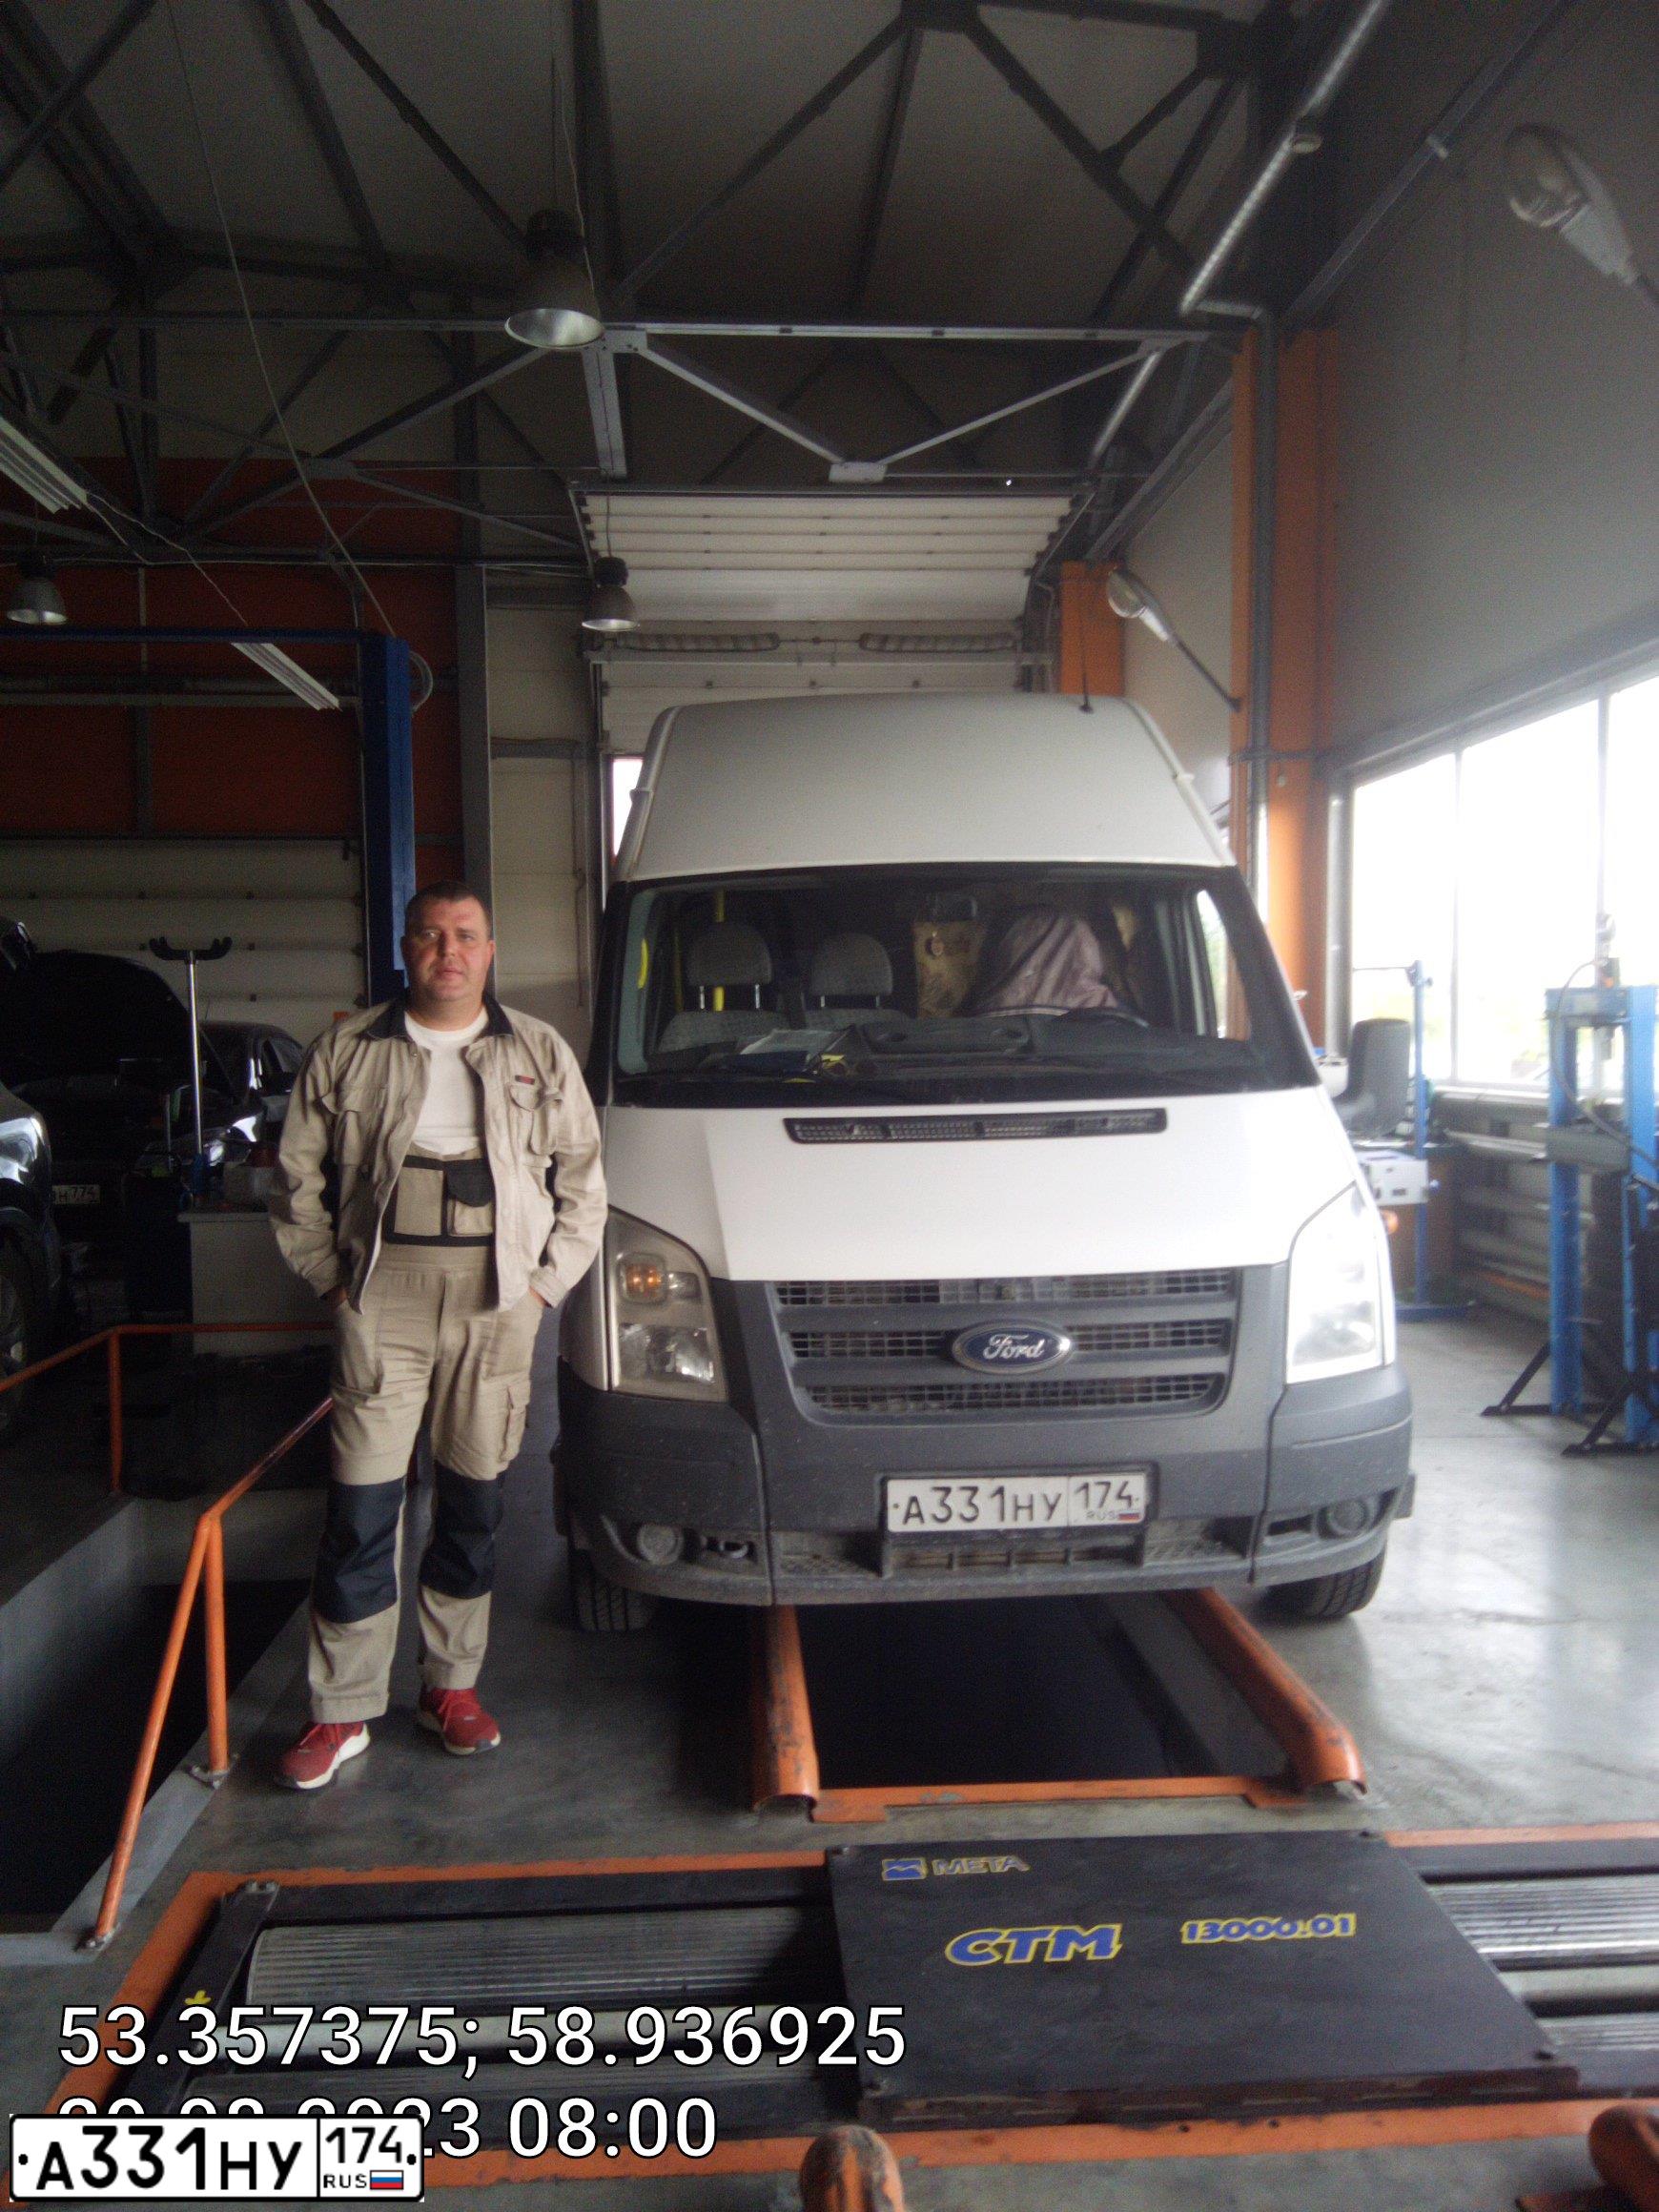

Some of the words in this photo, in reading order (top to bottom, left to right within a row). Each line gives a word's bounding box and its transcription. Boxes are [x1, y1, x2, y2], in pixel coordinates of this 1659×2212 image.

[982, 1334, 1046, 1360] Ford
[902, 1485, 1062, 1526] А331НУ
[1075, 1480, 1135, 1509] 174
[1180, 1913, 1357, 1944] 13000.01
